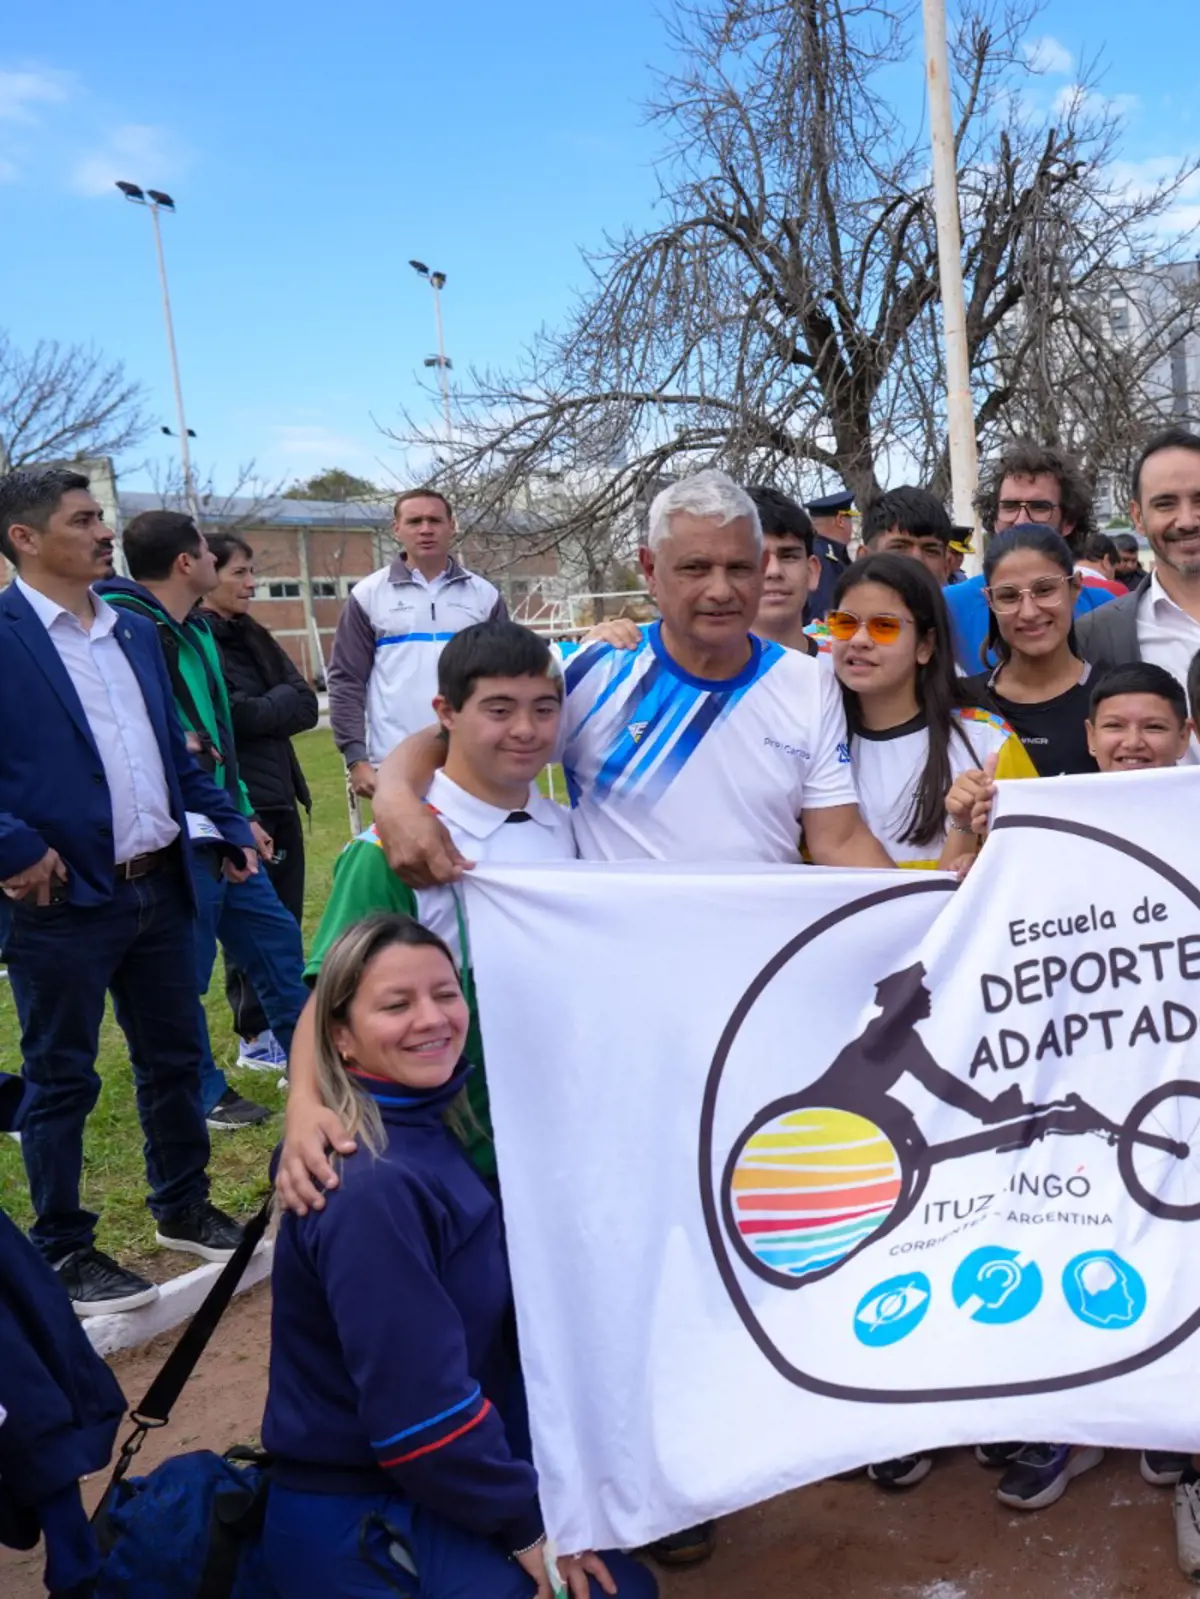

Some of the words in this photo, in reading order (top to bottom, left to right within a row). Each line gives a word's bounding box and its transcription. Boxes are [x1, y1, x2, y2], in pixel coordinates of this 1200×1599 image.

[1008, 904, 1117, 947] Escuela
[1132, 895, 1169, 924] de
[922, 1165, 1092, 1225] ITUZINGÓ
[1006, 1210, 1114, 1226] ARGENTINA
